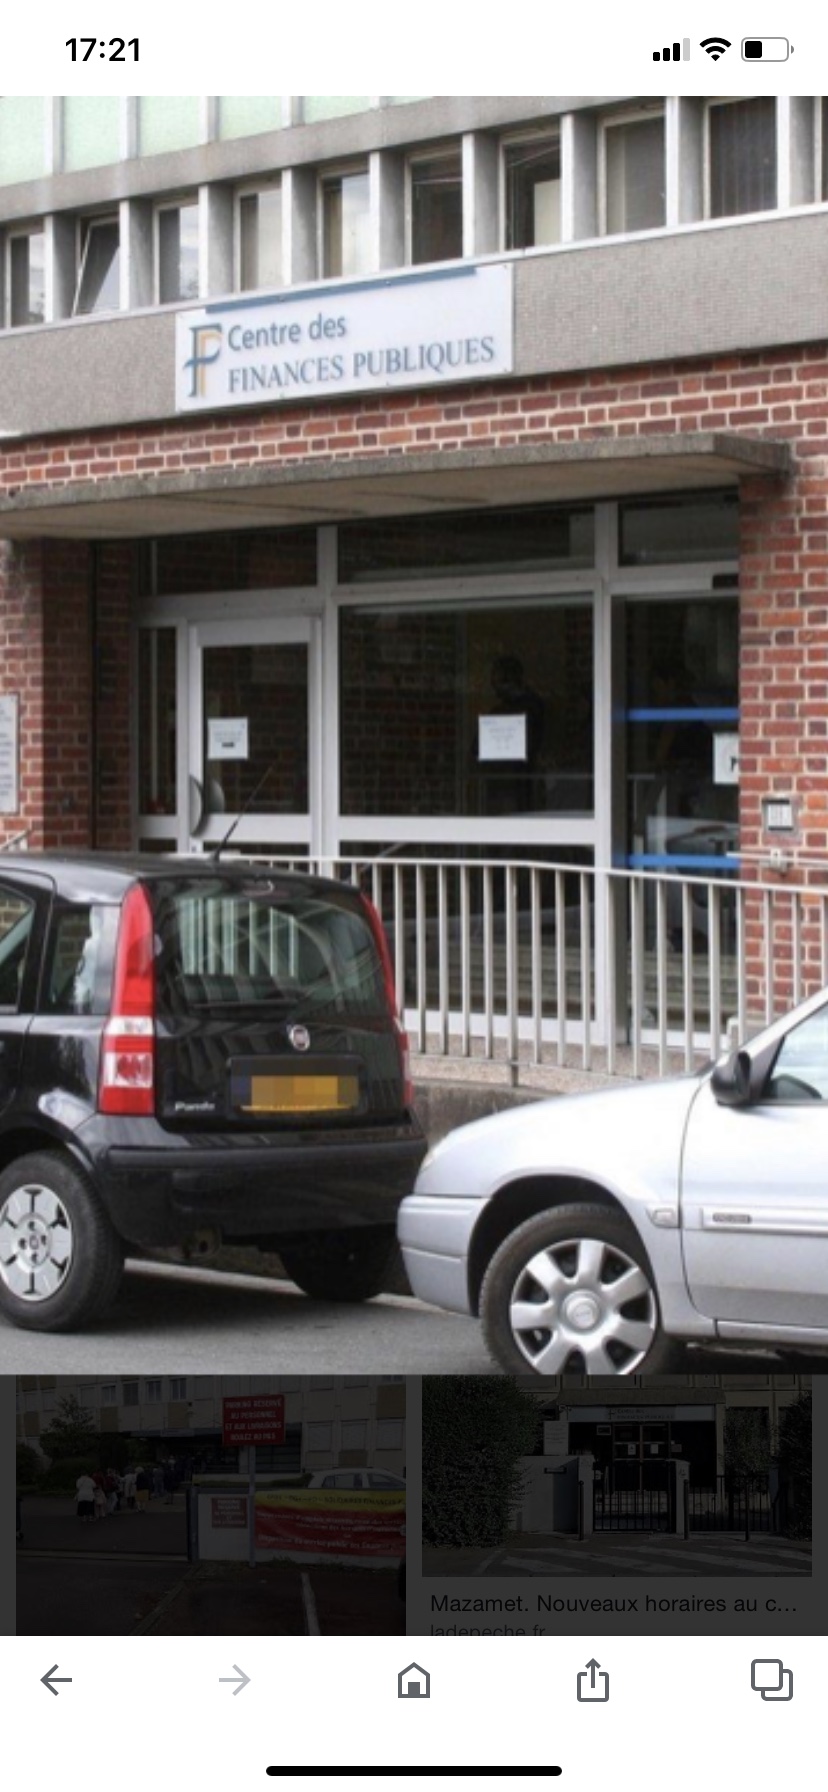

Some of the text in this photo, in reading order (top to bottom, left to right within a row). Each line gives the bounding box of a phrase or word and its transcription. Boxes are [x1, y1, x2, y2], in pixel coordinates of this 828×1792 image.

[228, 312, 346, 352] Centre des
[228, 336, 496, 394] FINANCES PUBLIQUES
